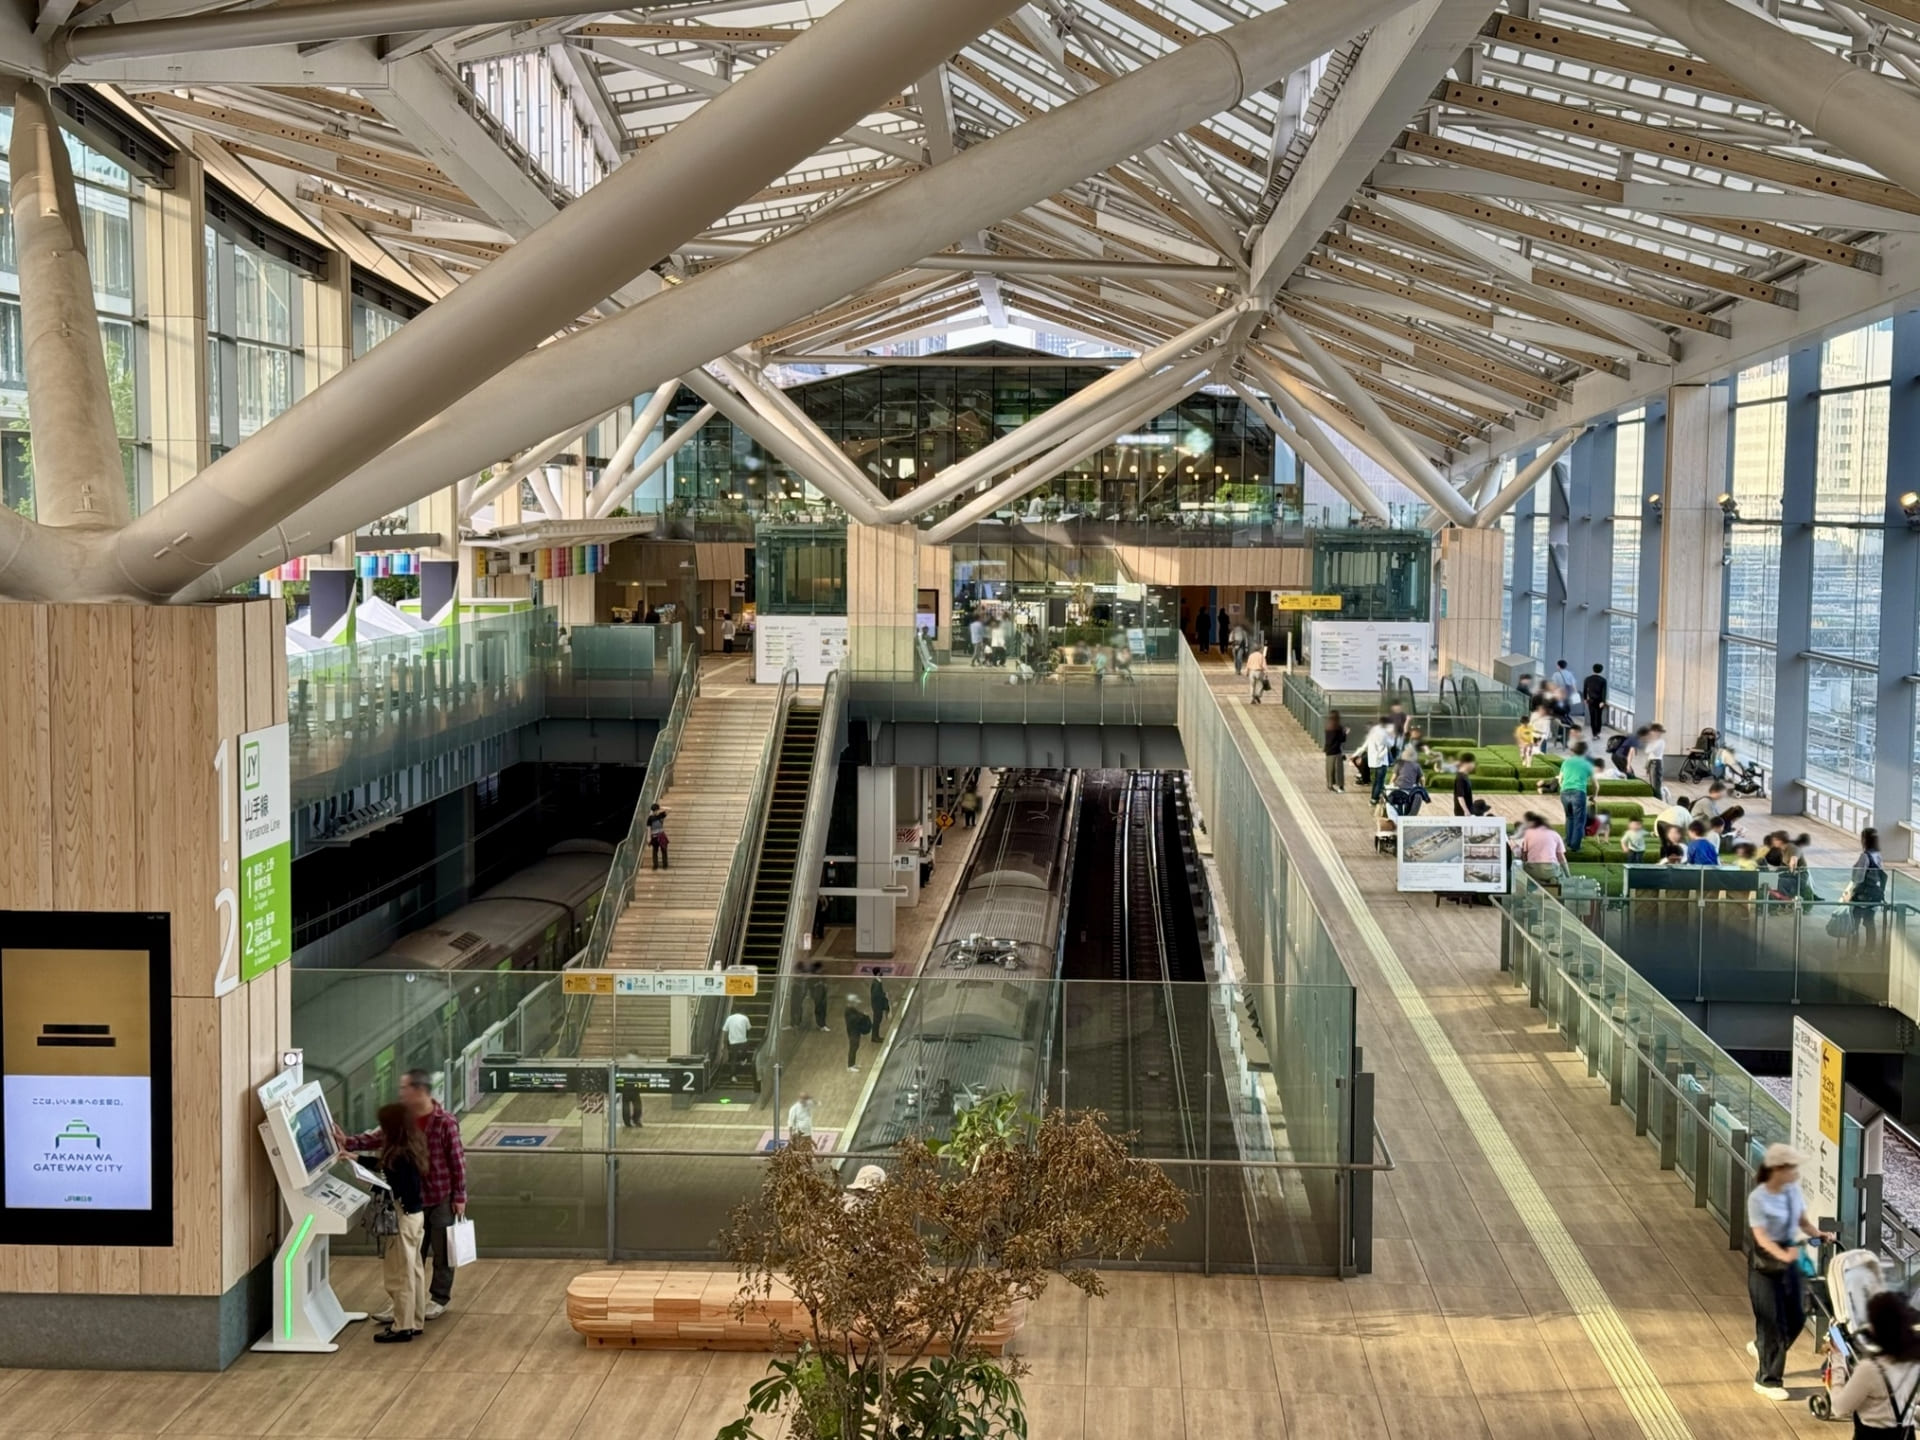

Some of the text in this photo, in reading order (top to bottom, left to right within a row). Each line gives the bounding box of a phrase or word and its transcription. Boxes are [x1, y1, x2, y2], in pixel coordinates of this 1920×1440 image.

[247, 754, 258, 778] JY
[245, 794, 270, 822] 山手線
[489, 1071, 497, 1090] 1
[682, 1071, 695, 1091] 2
[44, 1153, 113, 1161] TAKANAWA
[33, 1163, 123, 1173] GATEWAY CITY
